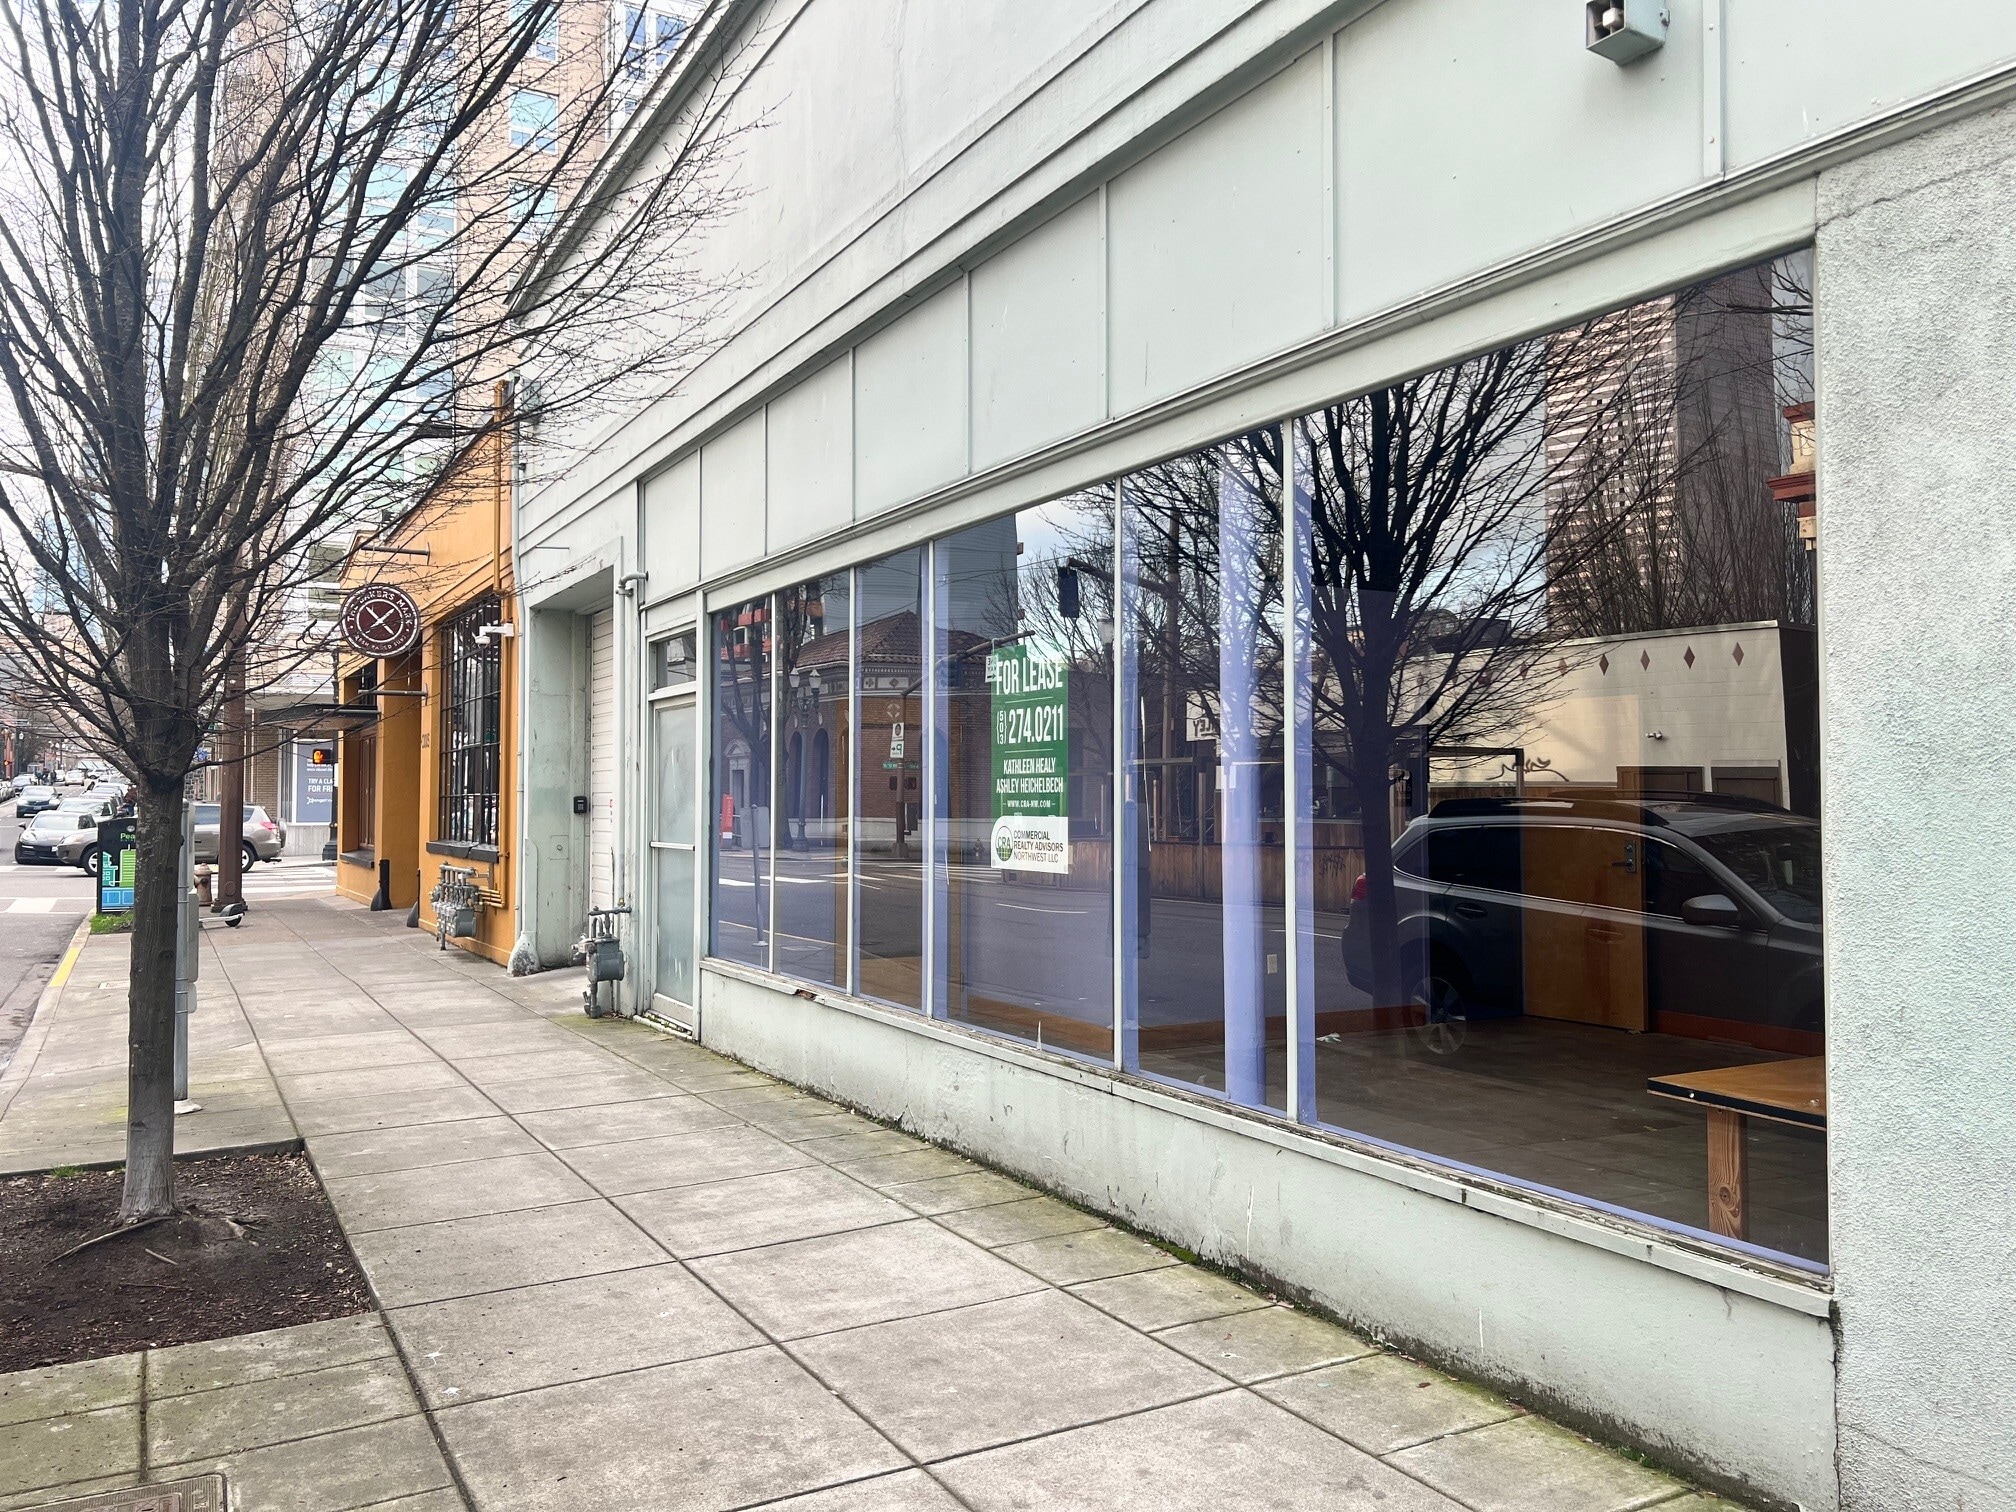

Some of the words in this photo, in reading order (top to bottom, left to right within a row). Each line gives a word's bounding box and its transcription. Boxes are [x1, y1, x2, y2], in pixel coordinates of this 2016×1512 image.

[396, 599, 413, 626] MARK
[996, 659, 1019, 695] FOR
[1023, 656, 1063, 692] LEASE
[1009, 704, 1063, 744] 274.0211
[1003, 758, 1034, 774] KATHLEEN
[1036, 757, 1056, 773] HEALY
[996, 778, 1019, 793] ASHLEY
[1020, 777, 1063, 793] HEICHELBECH
[997, 836, 1010, 849] CRA
[1013, 830, 1050, 840] COMMERCIAL
[1013, 840, 1034, 850] REALTY
[1034, 842, 1063, 852] ADVISORS
[1013, 851, 1047, 862] NORTHWEST
[1048, 853, 1058, 863] LLC
